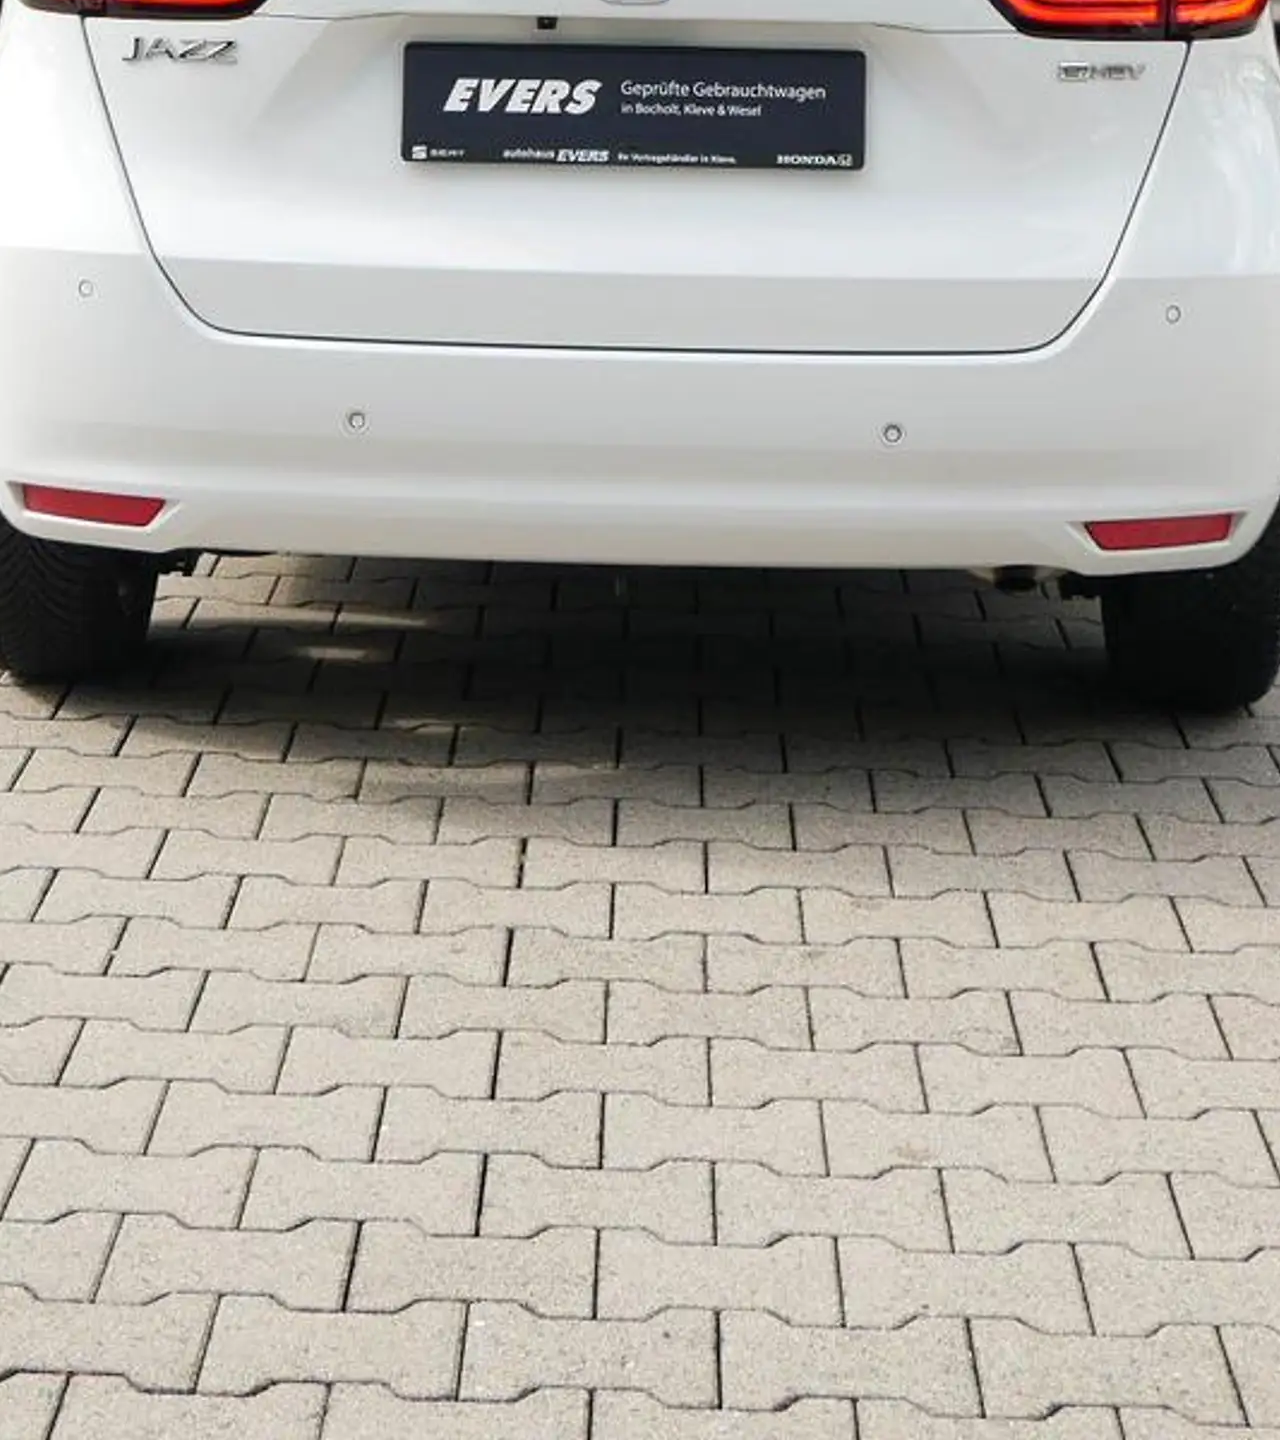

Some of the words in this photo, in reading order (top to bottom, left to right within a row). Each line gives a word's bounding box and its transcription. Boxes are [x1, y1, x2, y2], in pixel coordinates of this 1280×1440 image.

[122, 36, 238, 65] JAZZ
[443, 78, 602, 115] EVERS
[620, 79, 690, 99] Geprüfte
[692, 81, 826, 103] Gebrauchtwagen
[621, 103, 634, 115] in
[683, 104, 715, 117] Kleve
[717, 105, 726, 117] &
[728, 105, 762, 117] Wesel
[556, 148, 609, 163] EVERS
[776, 153, 838, 166] HONDA
